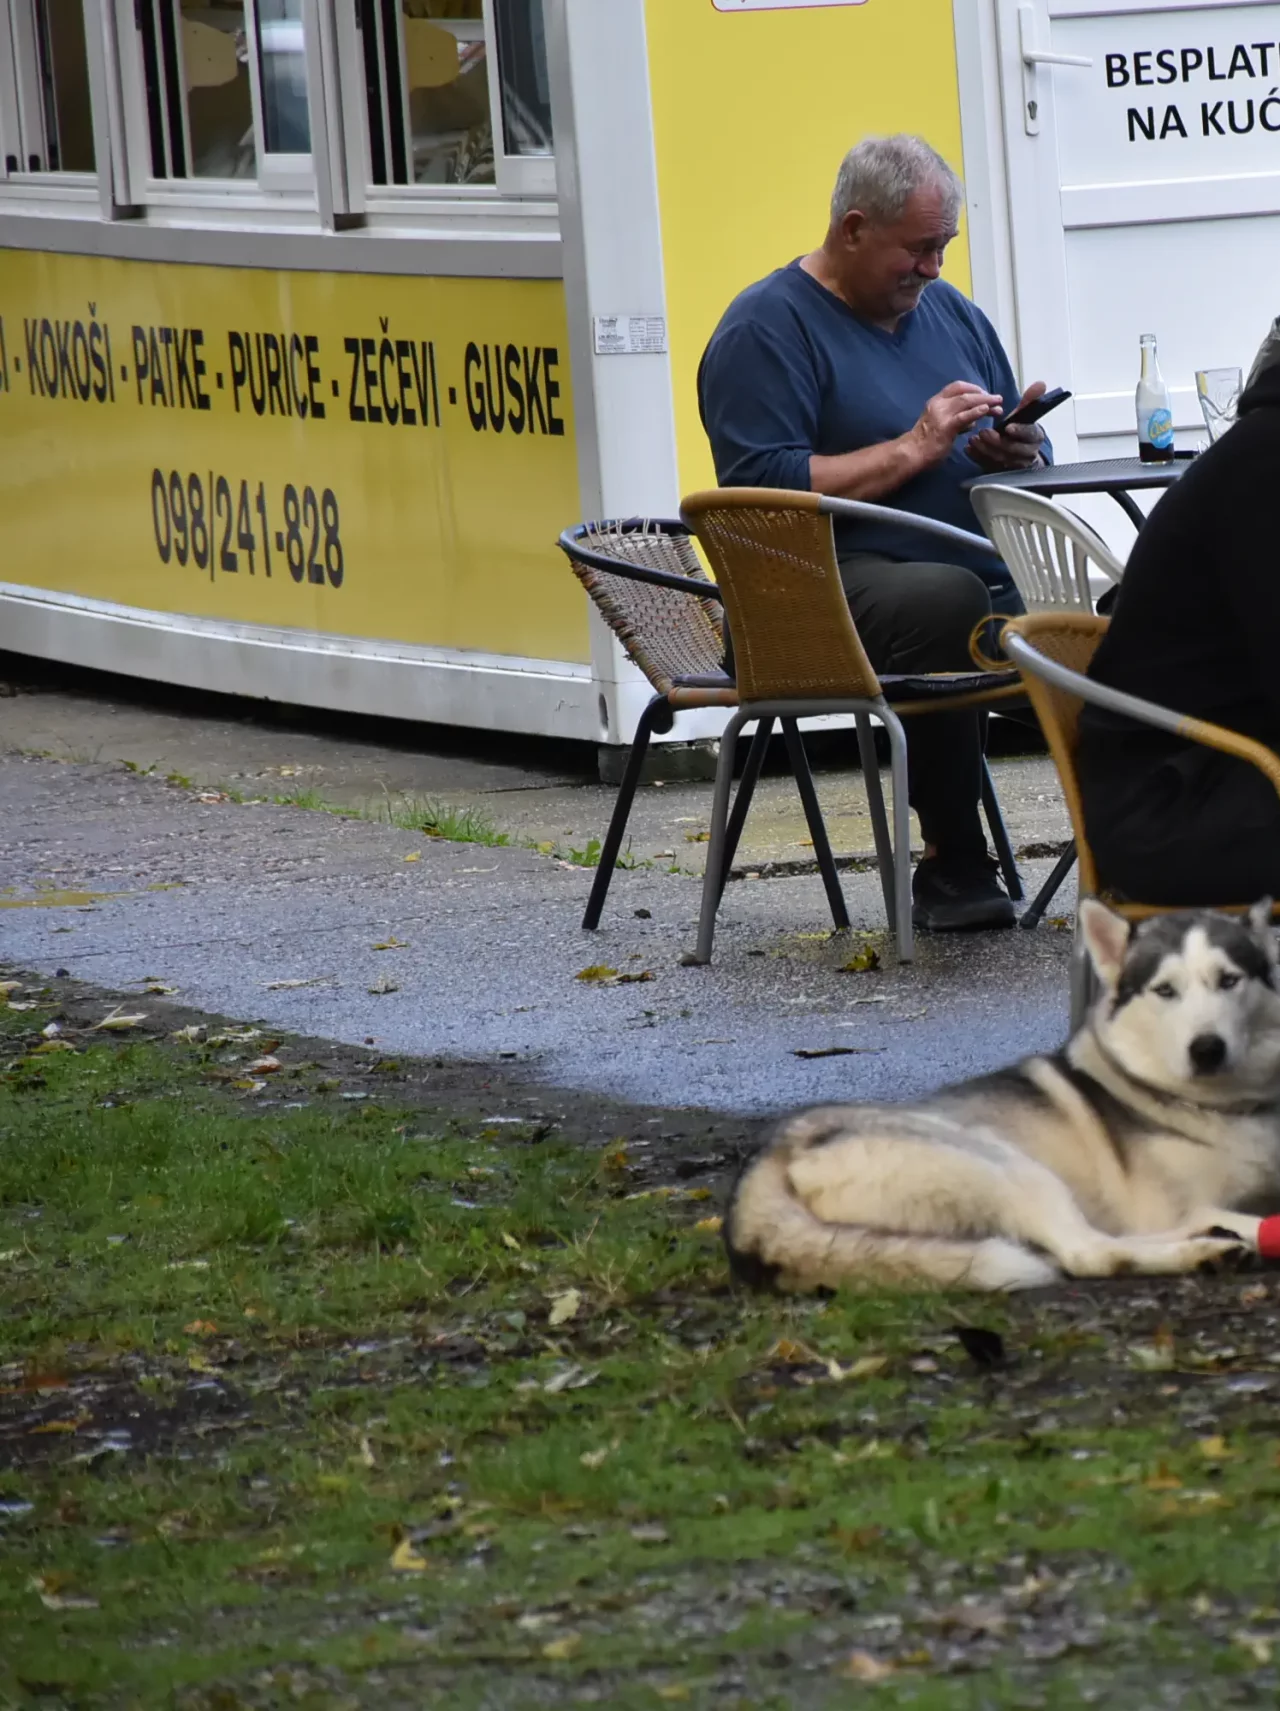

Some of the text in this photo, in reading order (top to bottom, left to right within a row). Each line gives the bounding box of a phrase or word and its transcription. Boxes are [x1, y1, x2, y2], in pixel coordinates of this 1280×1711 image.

[1127, 105, 1188, 142] NA
[23, 301, 116, 404] KOKOŠI
[131, 325, 212, 411] PATKE
[227, 330, 326, 420] PURICE
[343, 316, 441, 428] ZEČEVI
[464, 341, 565, 437] GUSKE
